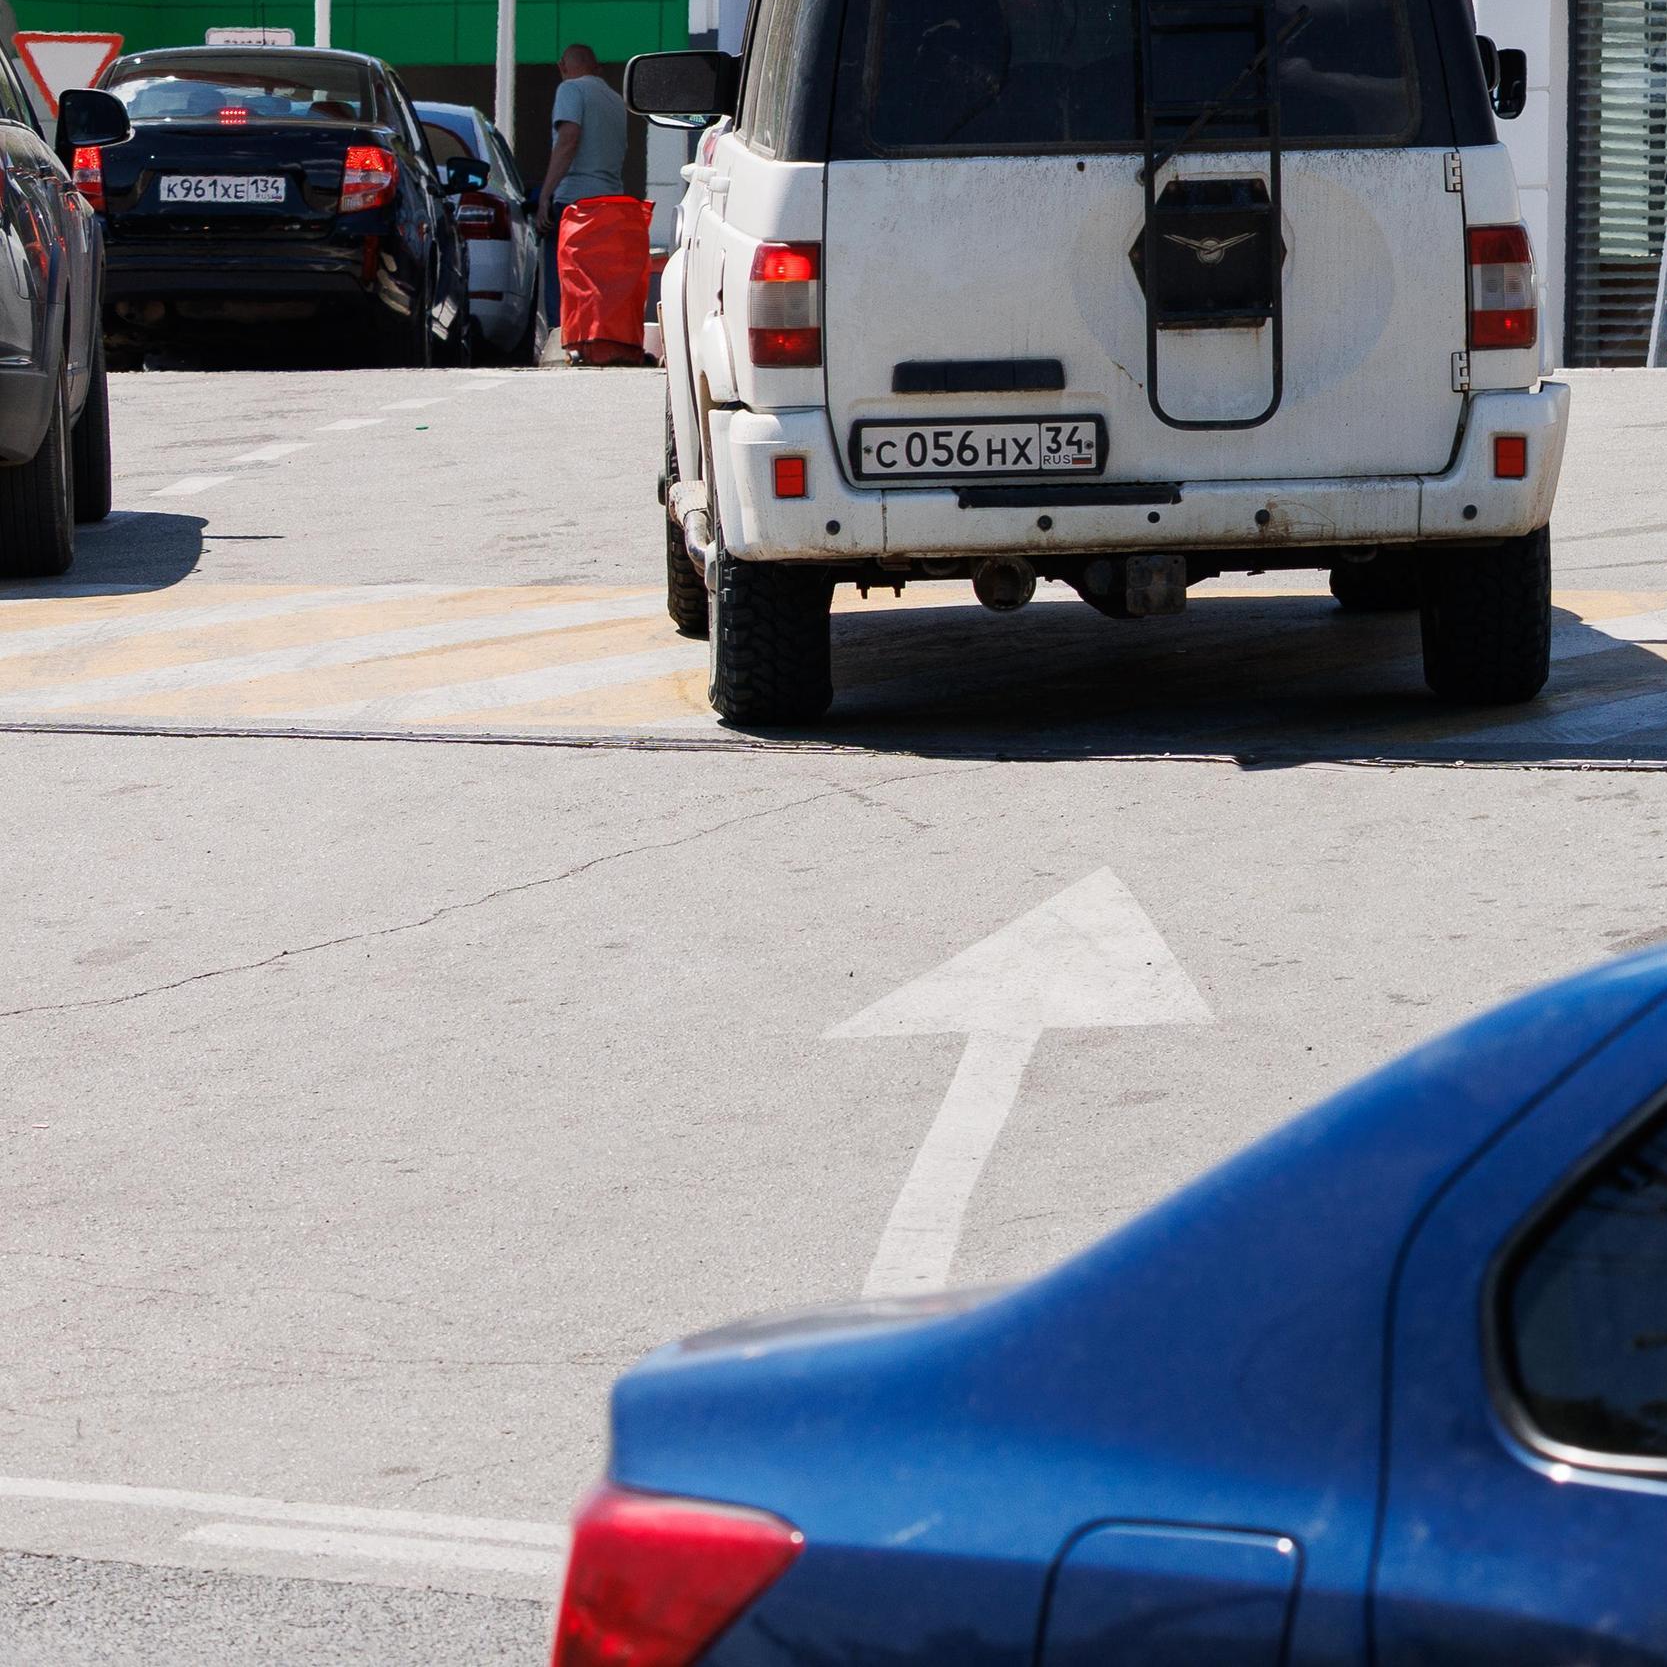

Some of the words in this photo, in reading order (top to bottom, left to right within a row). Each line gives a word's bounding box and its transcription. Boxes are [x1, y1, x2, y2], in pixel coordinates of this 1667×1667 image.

[166, 178, 245, 199] К961ХЕ
[250, 178, 280, 194] 134
[875, 430, 1033, 469] С056НХ
[1045, 425, 1083, 454] 34
[1043, 454, 1071, 465] RUS
